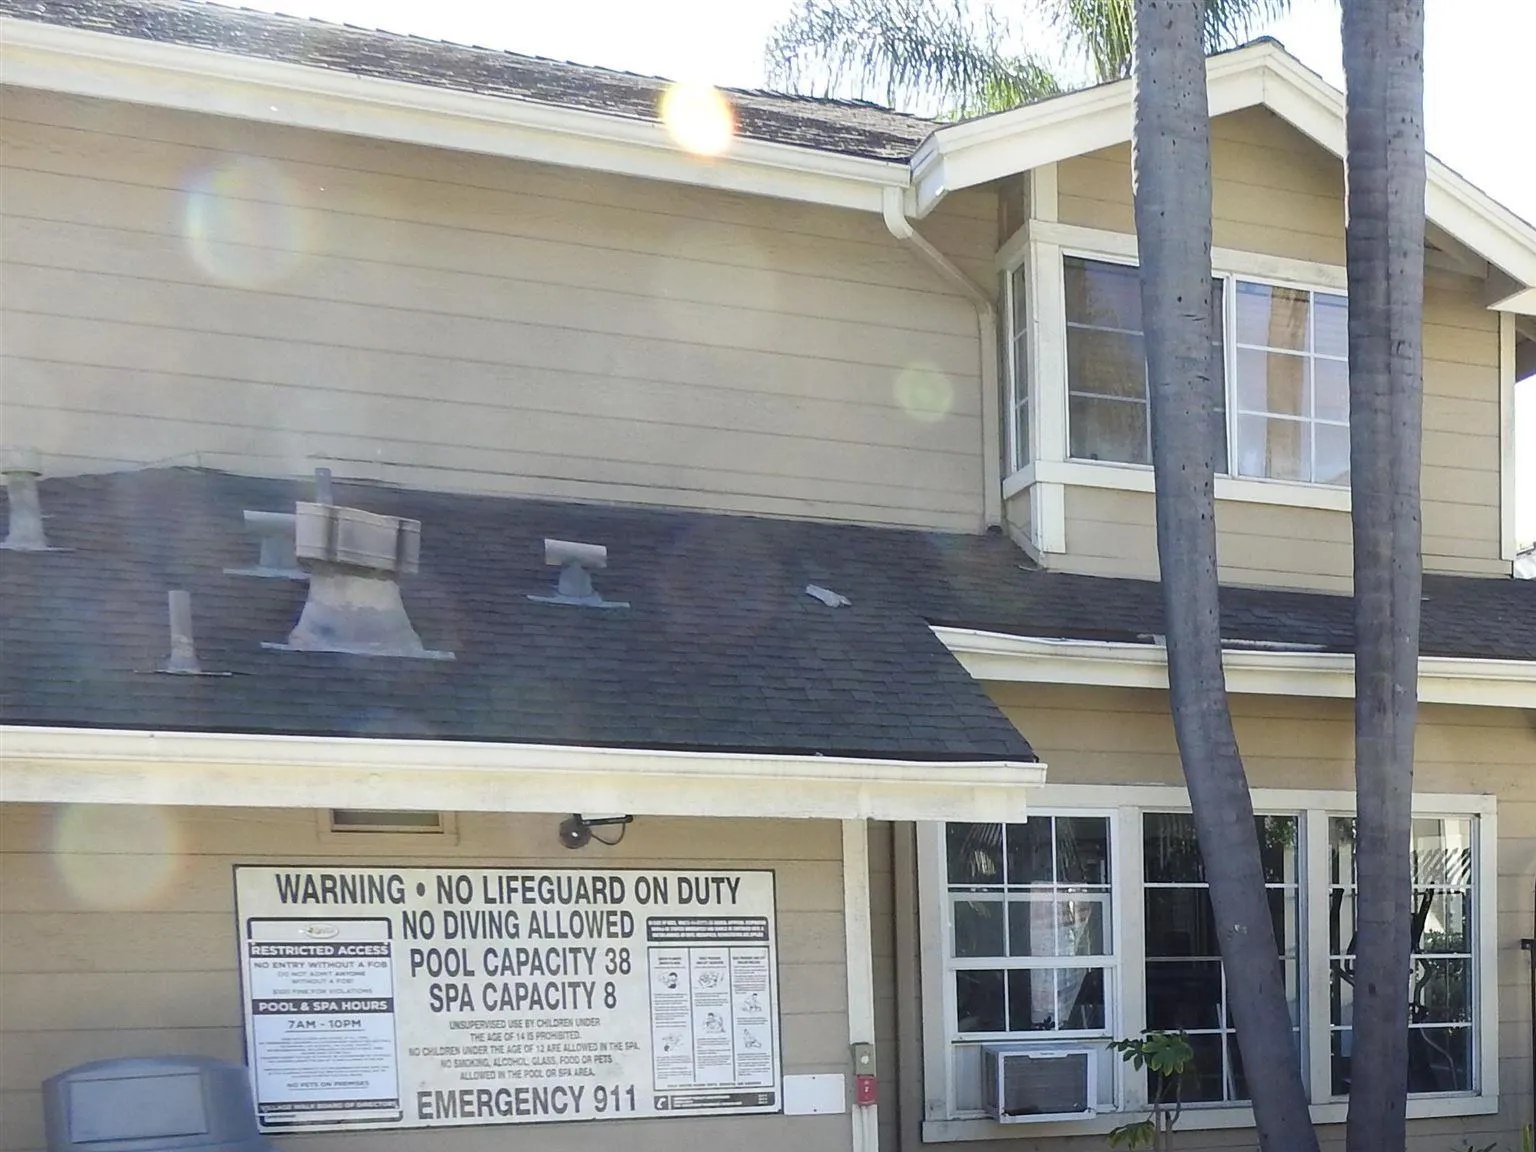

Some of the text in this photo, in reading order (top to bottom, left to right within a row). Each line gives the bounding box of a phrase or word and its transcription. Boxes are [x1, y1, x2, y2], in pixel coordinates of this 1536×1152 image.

[275, 873, 741, 905] WARNING NO LIFEGUARD ON DUTY
[402, 910, 435, 939] NO
[444, 910, 520, 939] DIVING
[528, 910, 634, 939] ALLOWED
[252, 945, 389, 956] RESTRICTED ACCESS
[410, 947, 631, 977] POOL CAPACITY 38
[259, 1001, 388, 1012] POOL & SPA HOURS
[429, 981, 617, 1013] SPA CAPACITY 8
[288, 1020, 316, 1029] 7AM
[329, 1019, 362, 1028] 10PM
[449, 1017, 600, 1030] UNSUPERVISED USE BY CHILDREN UNDER
[470, 1032, 485, 1042] THE
[487, 1032, 502, 1041] AGE
[504, 1032, 514, 1041] OF
[516, 1032, 525, 1040] 14
[527, 1031, 534, 1040] IS
[416, 1085, 585, 1120] EMERGENCY
[593, 1084, 636, 1113] 911
